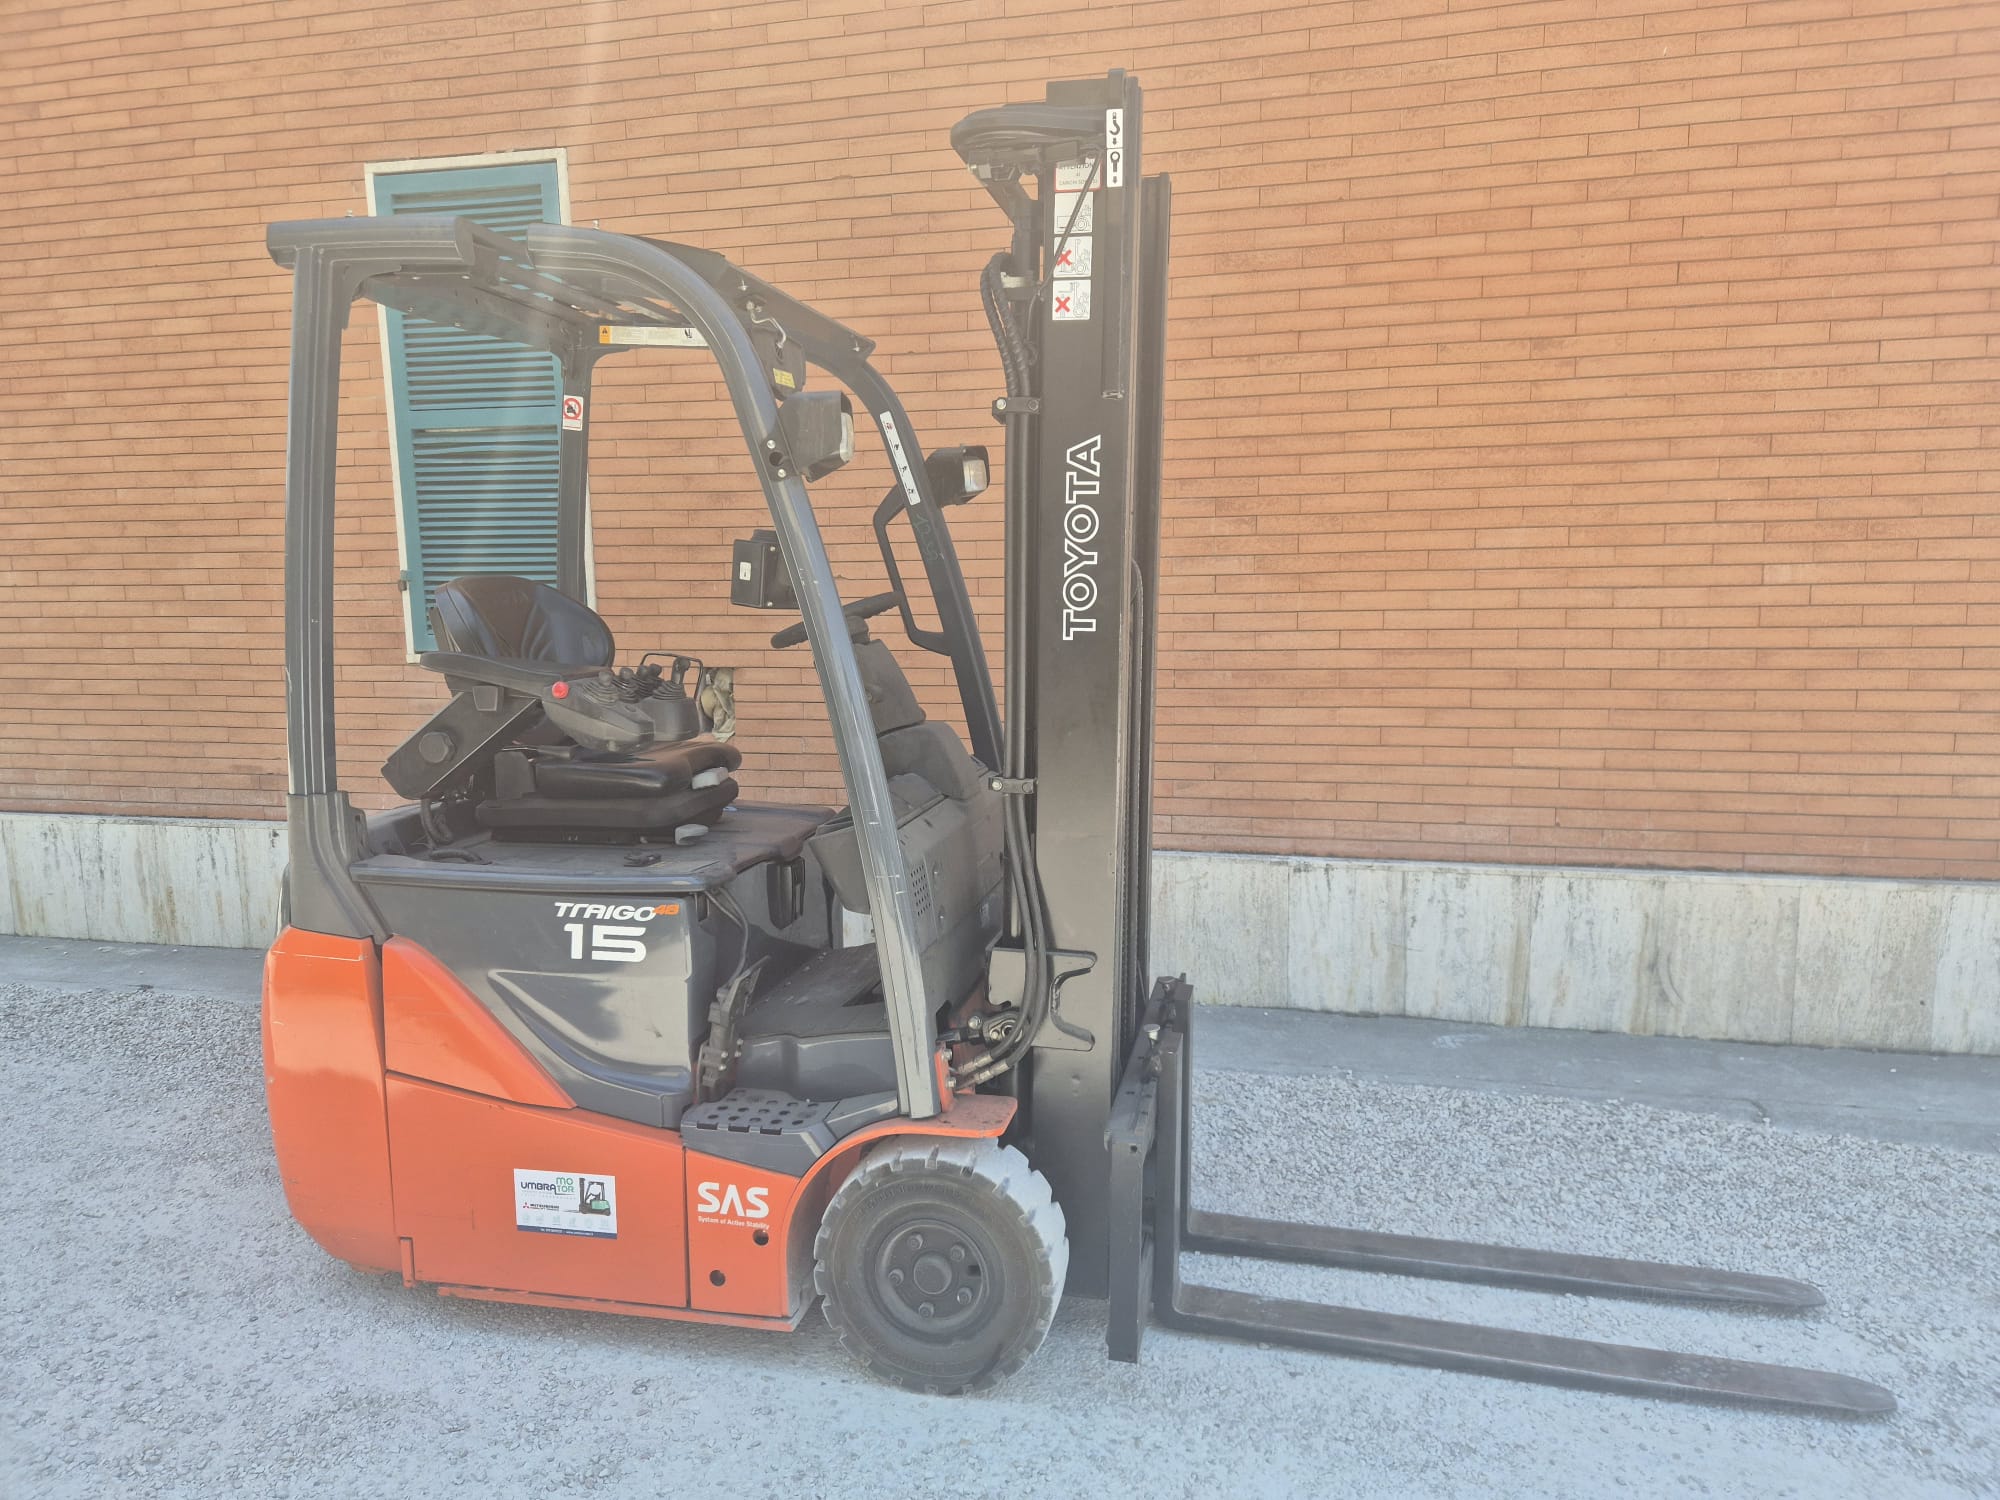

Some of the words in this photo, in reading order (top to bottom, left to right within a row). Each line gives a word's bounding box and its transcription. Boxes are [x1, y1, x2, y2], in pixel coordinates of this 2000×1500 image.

[1063, 434, 1101, 640] TOYOTA
[564, 923, 646, 963] 15
[520, 1181, 556, 1191] UMBRA
[698, 1181, 769, 1218] SAS
[698, 1215, 719, 1224] System
[727, 1219, 745, 1227] Active
[746, 1221, 770, 1231] Stability
